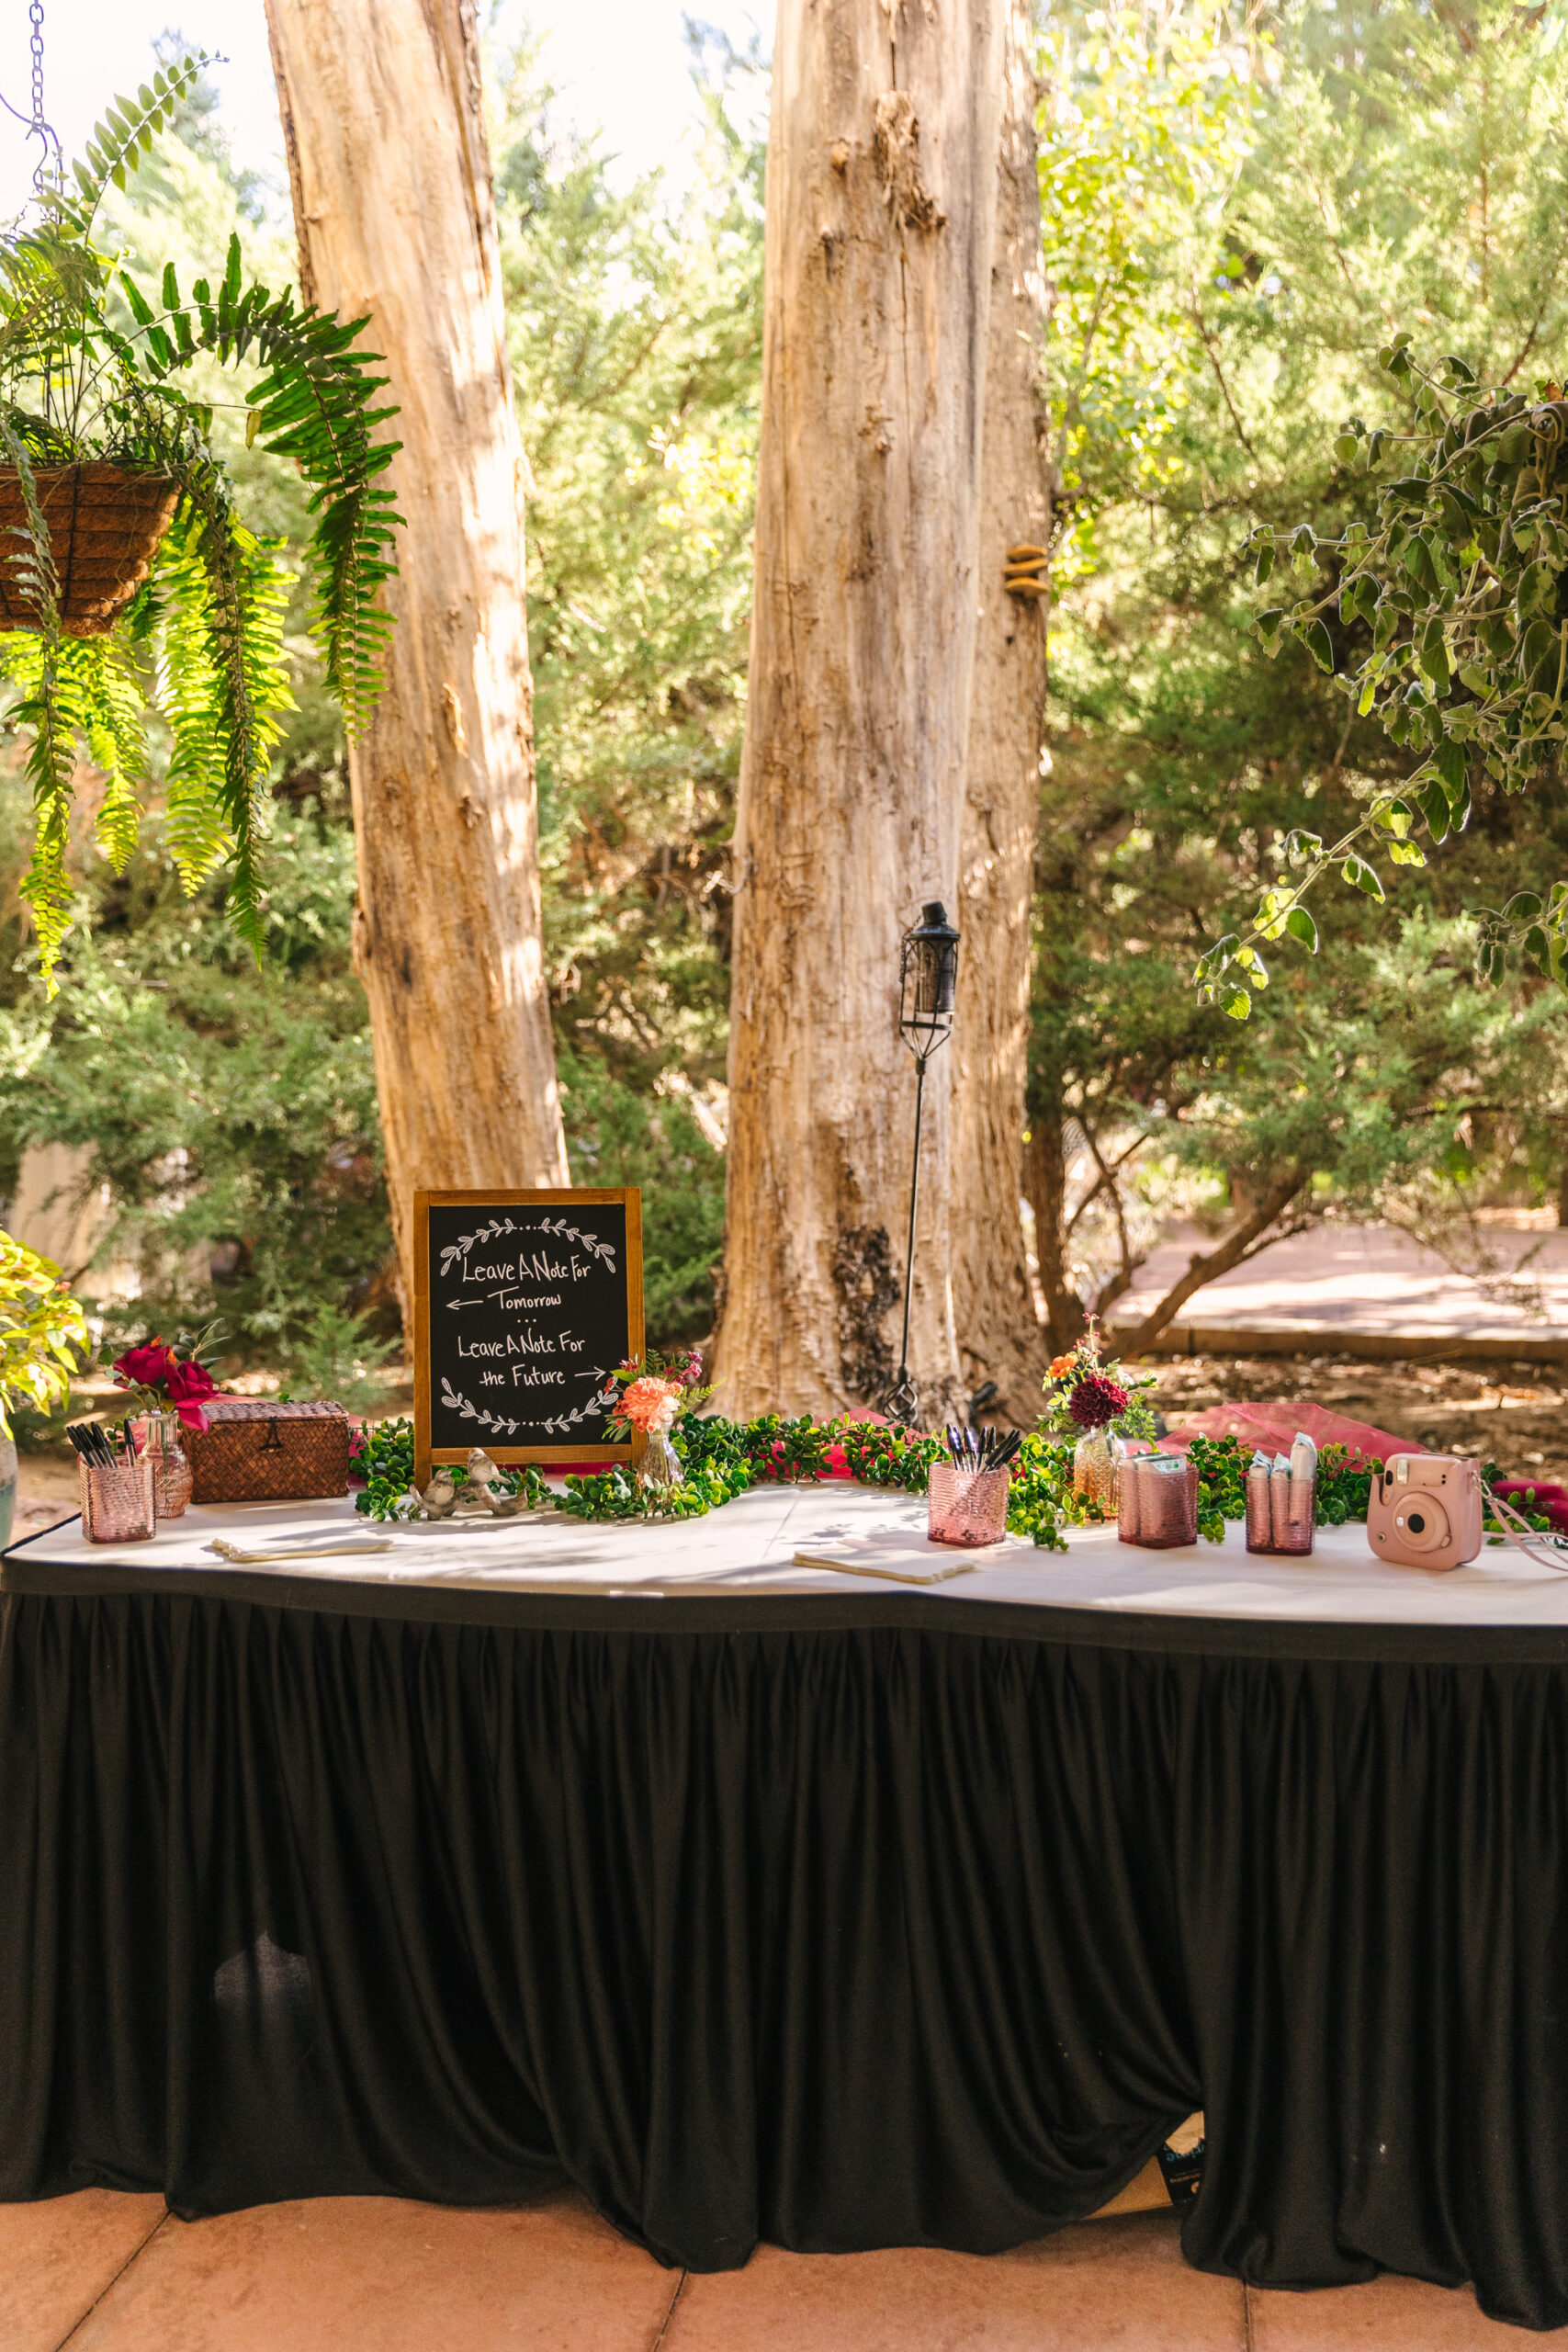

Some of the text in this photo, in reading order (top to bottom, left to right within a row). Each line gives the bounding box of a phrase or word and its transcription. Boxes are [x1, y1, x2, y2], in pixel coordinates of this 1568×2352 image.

[462, 1250, 592, 1283] Leave A Note For
[487, 1285, 561, 1310] Tomorrow
[457, 1328, 585, 1358] Leave A Note For
[479, 1363, 566, 1386] the Future
